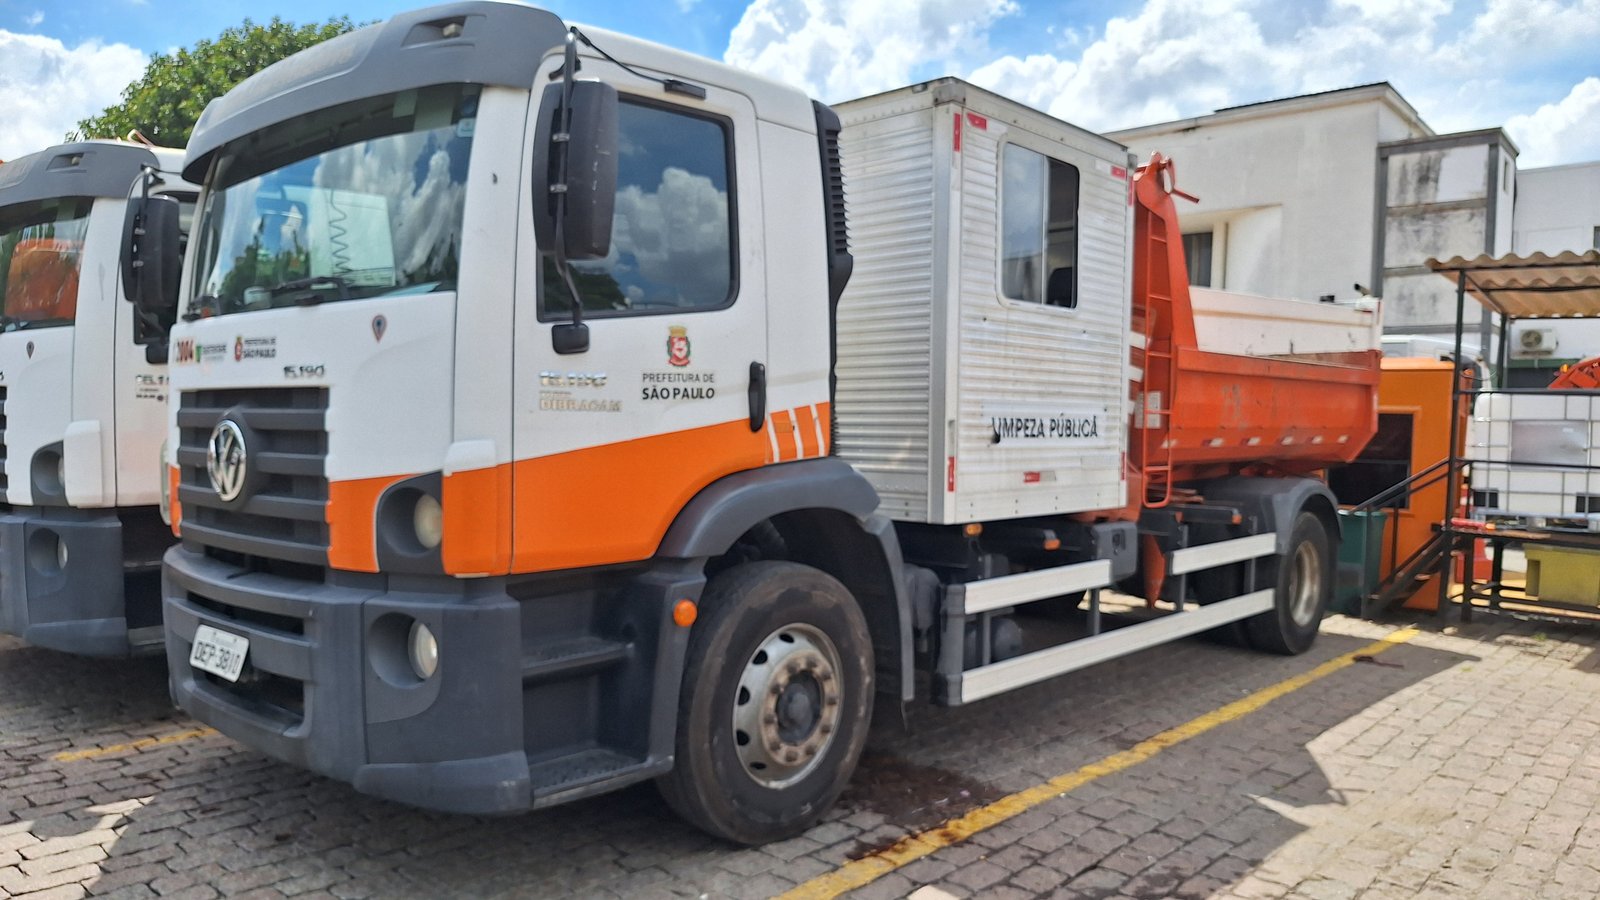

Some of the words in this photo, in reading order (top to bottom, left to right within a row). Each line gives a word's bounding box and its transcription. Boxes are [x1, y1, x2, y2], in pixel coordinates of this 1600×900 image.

[642, 373, 700, 383] PREFEITURA
[702, 373, 715, 383] DE
[642, 385, 670, 400] SÃO
[673, 387, 715, 400] PAULO
[991, 416, 1046, 439] LIMPEZA
[1049, 412, 1098, 437] PÚBLICA
